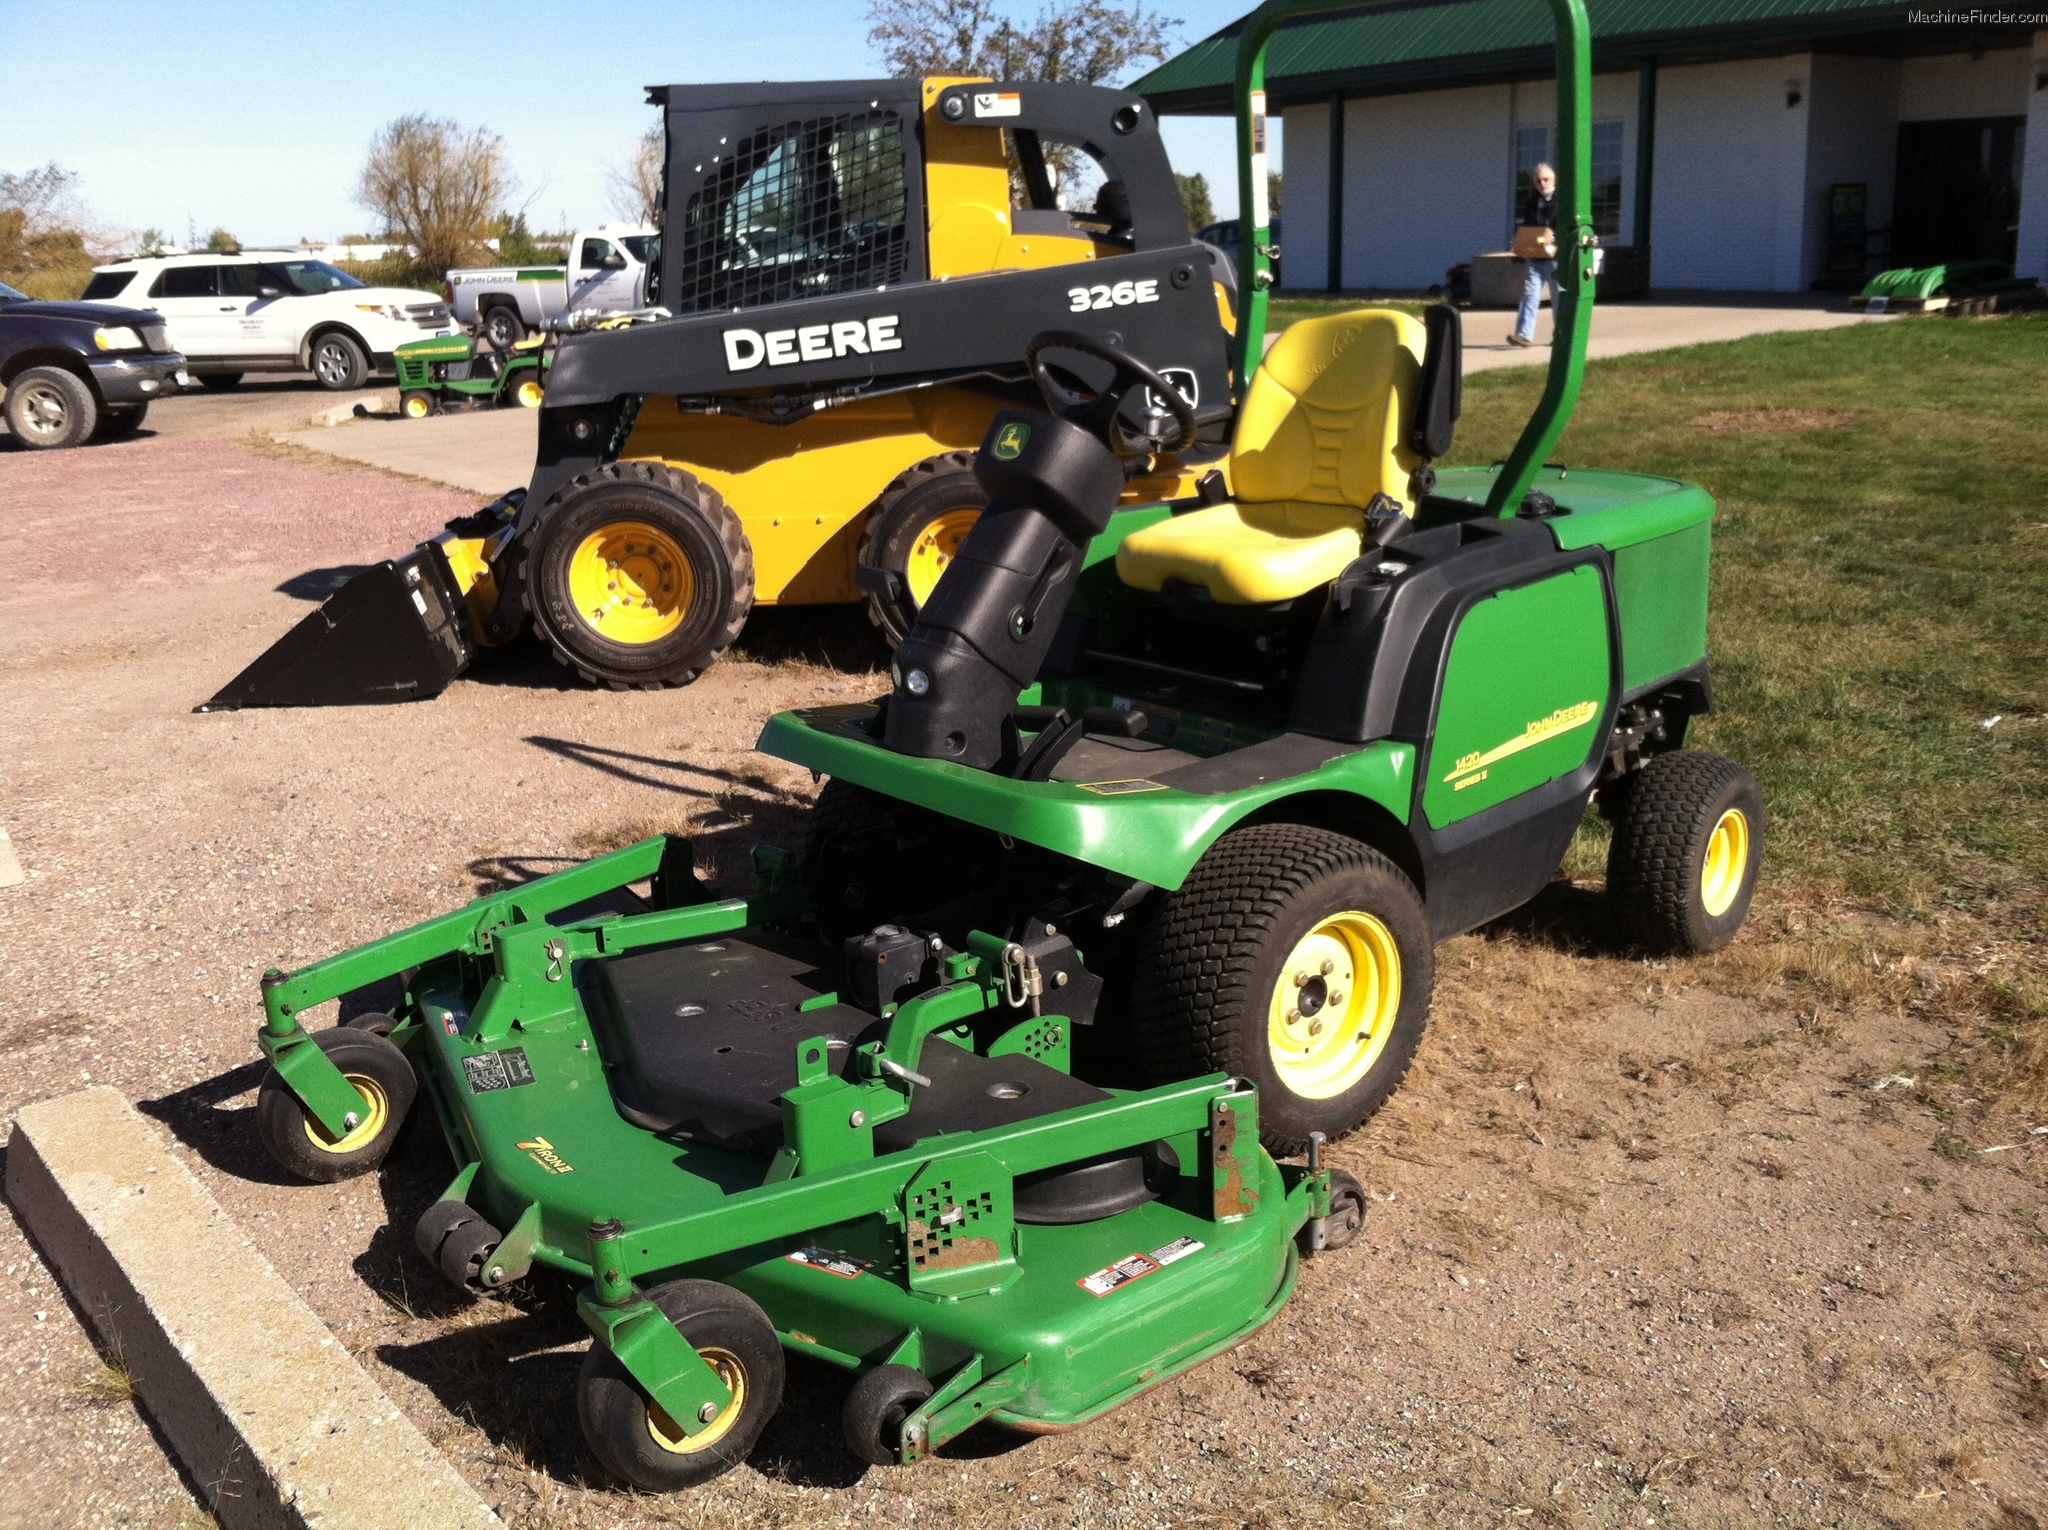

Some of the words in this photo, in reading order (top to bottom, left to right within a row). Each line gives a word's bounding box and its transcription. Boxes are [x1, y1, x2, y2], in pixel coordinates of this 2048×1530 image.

[462, 276, 485, 285] JOHN
[486, 275, 515, 284] DEERE
[1067, 279, 1160, 313] 326E
[723, 315, 902, 371] DEERE
[1524, 715, 1554, 739] JOHN
[1553, 702, 1590, 727] DEERE
[1455, 751, 1480, 772] 1420
